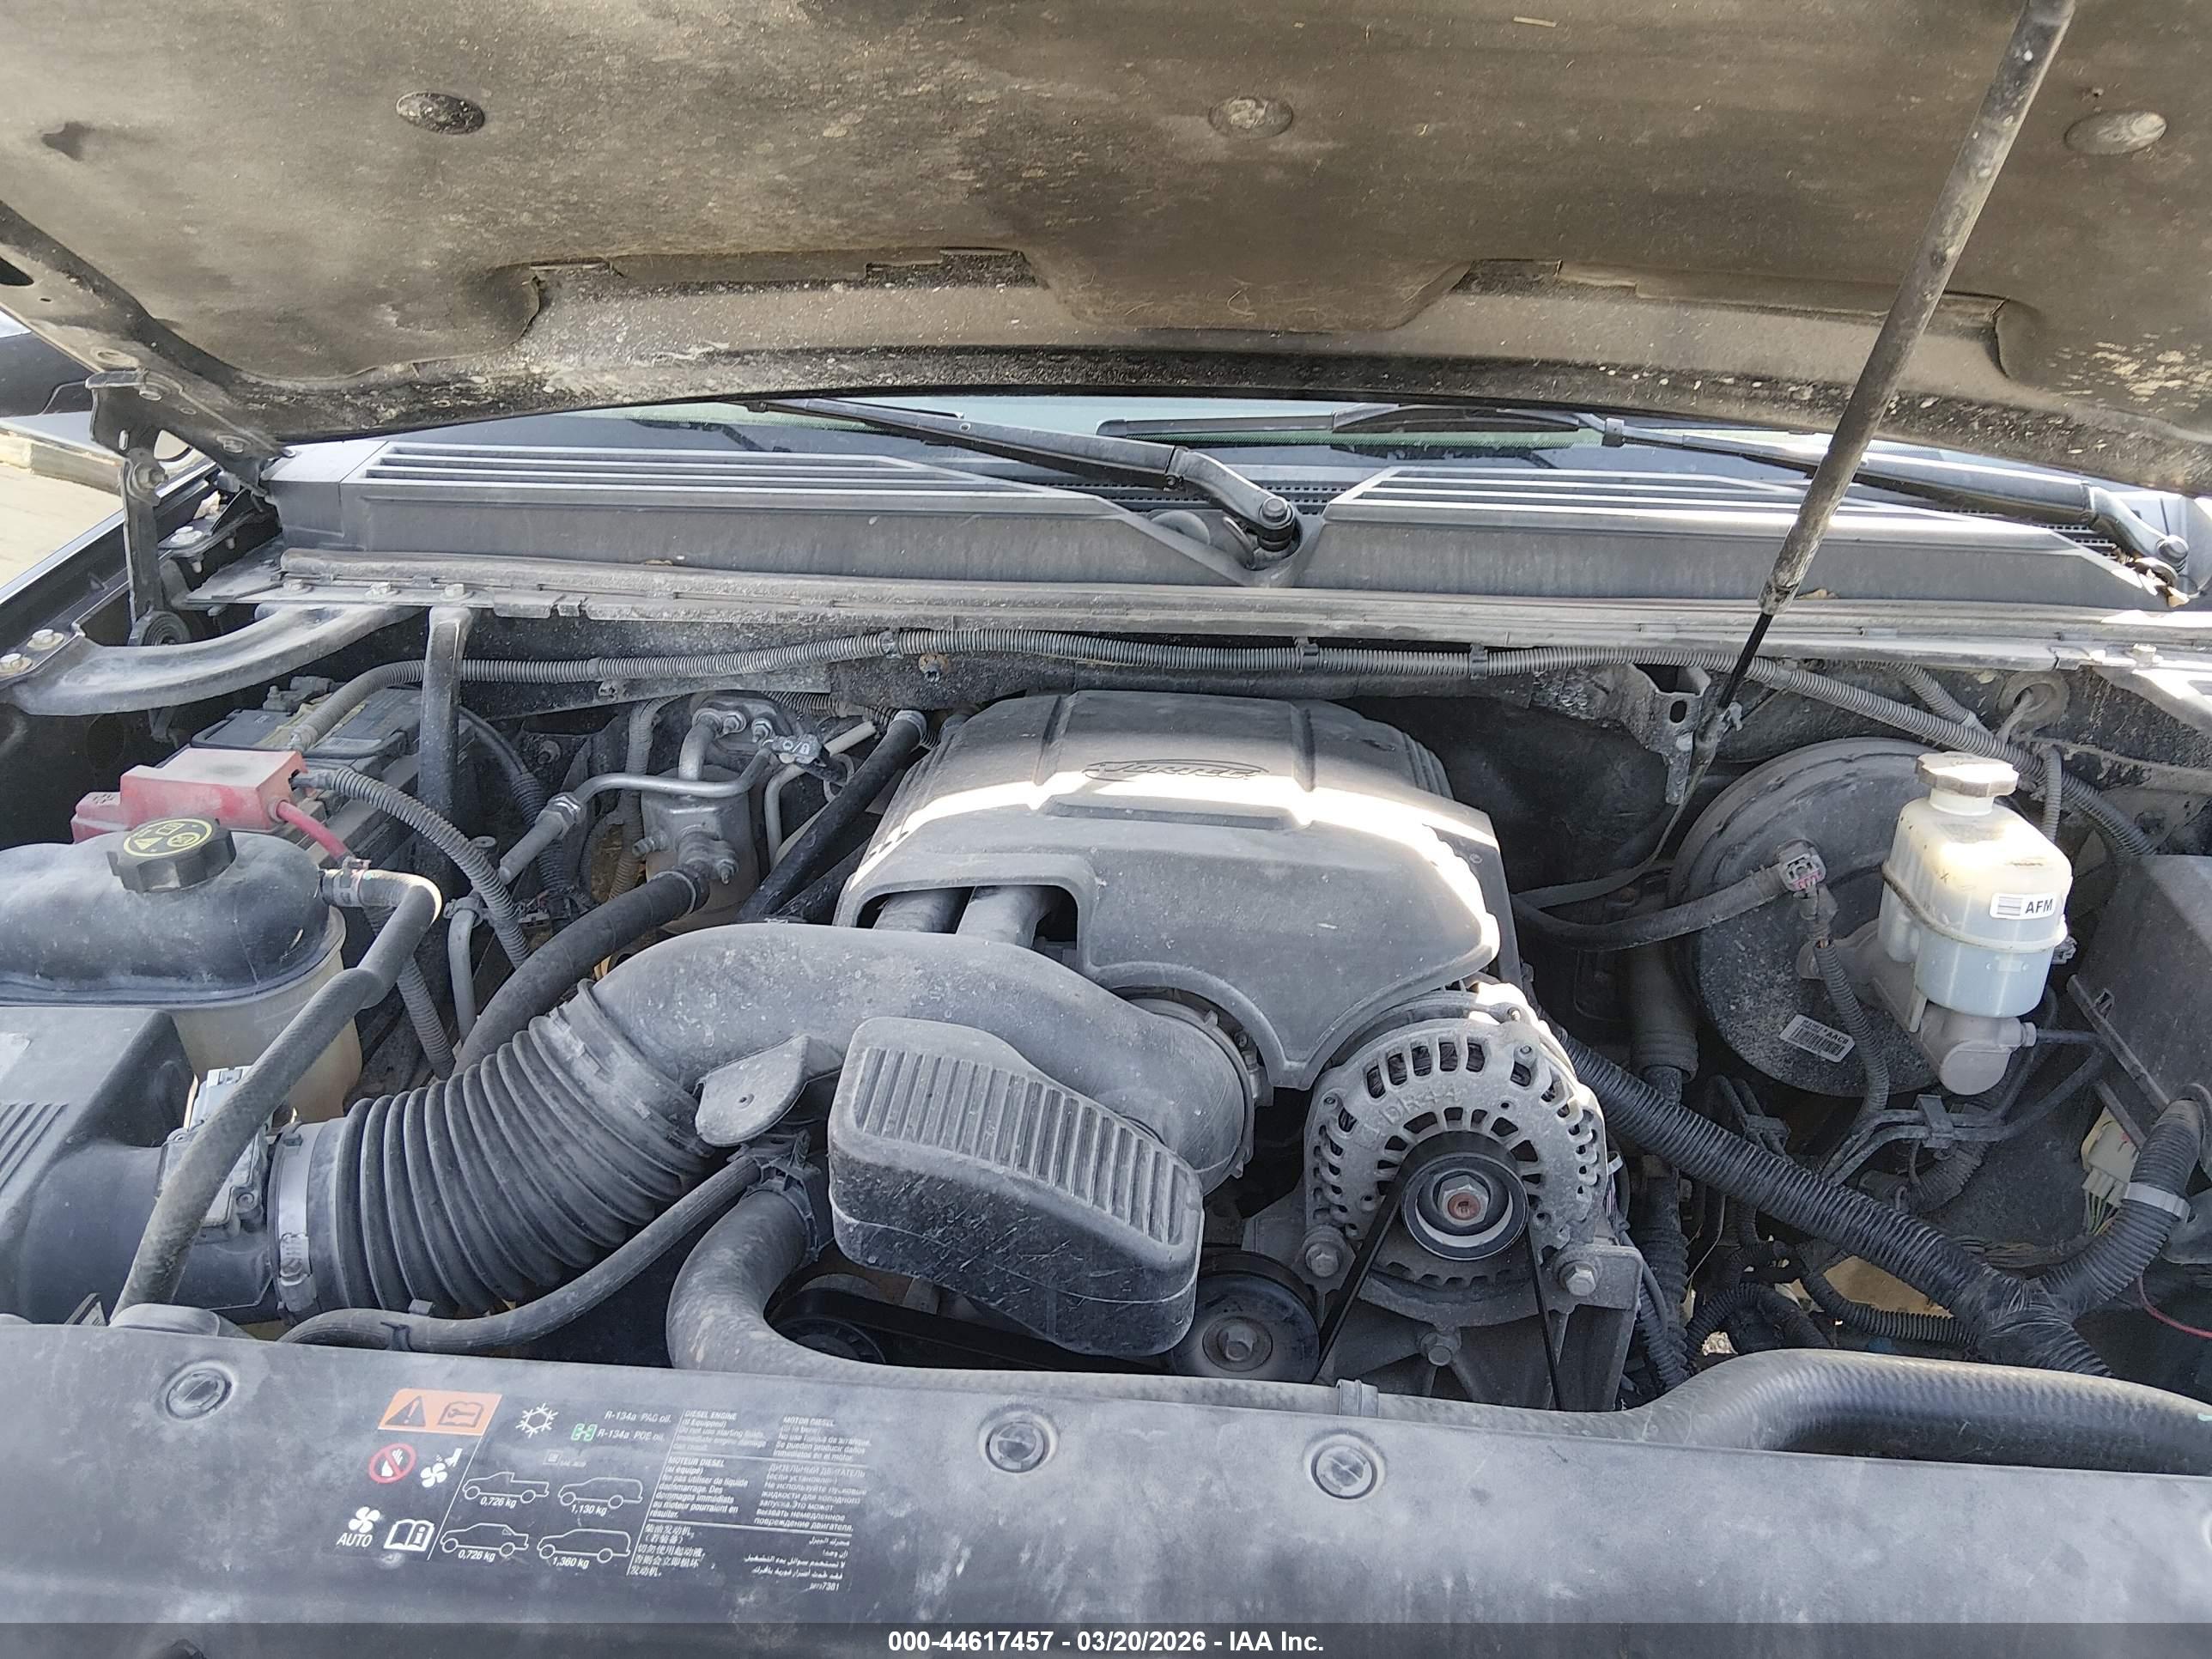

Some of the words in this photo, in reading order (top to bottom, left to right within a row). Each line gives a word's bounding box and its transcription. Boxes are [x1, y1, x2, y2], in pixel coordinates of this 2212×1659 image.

[2025, 898, 2054, 915] AFM
[605, 1410, 637, 1422] R-134a
[684, 1409, 708, 1418] DIESEL
[709, 1411, 738, 1419] ENGINE
[783, 1416, 809, 1425] MOTOR
[597, 1428, 629, 1440] R-134a
[667, 1455, 699, 1465] MOTEUR
[699, 1458, 725, 1467] DIESEL
[480, 1497, 504, 1507] 0,726
[505, 1498, 517, 1509] kg
[663, 1501, 690, 1510] moteur
[571, 1504, 594, 1514] 1,130
[595, 1506, 607, 1516] kg
[337, 1533, 374, 1547] AUTO
[458, 1550, 483, 1560] 0,726
[483, 1552, 496, 1562] kg
[552, 1557, 577, 1567] 1,360
[578, 1559, 590, 1569] kg
